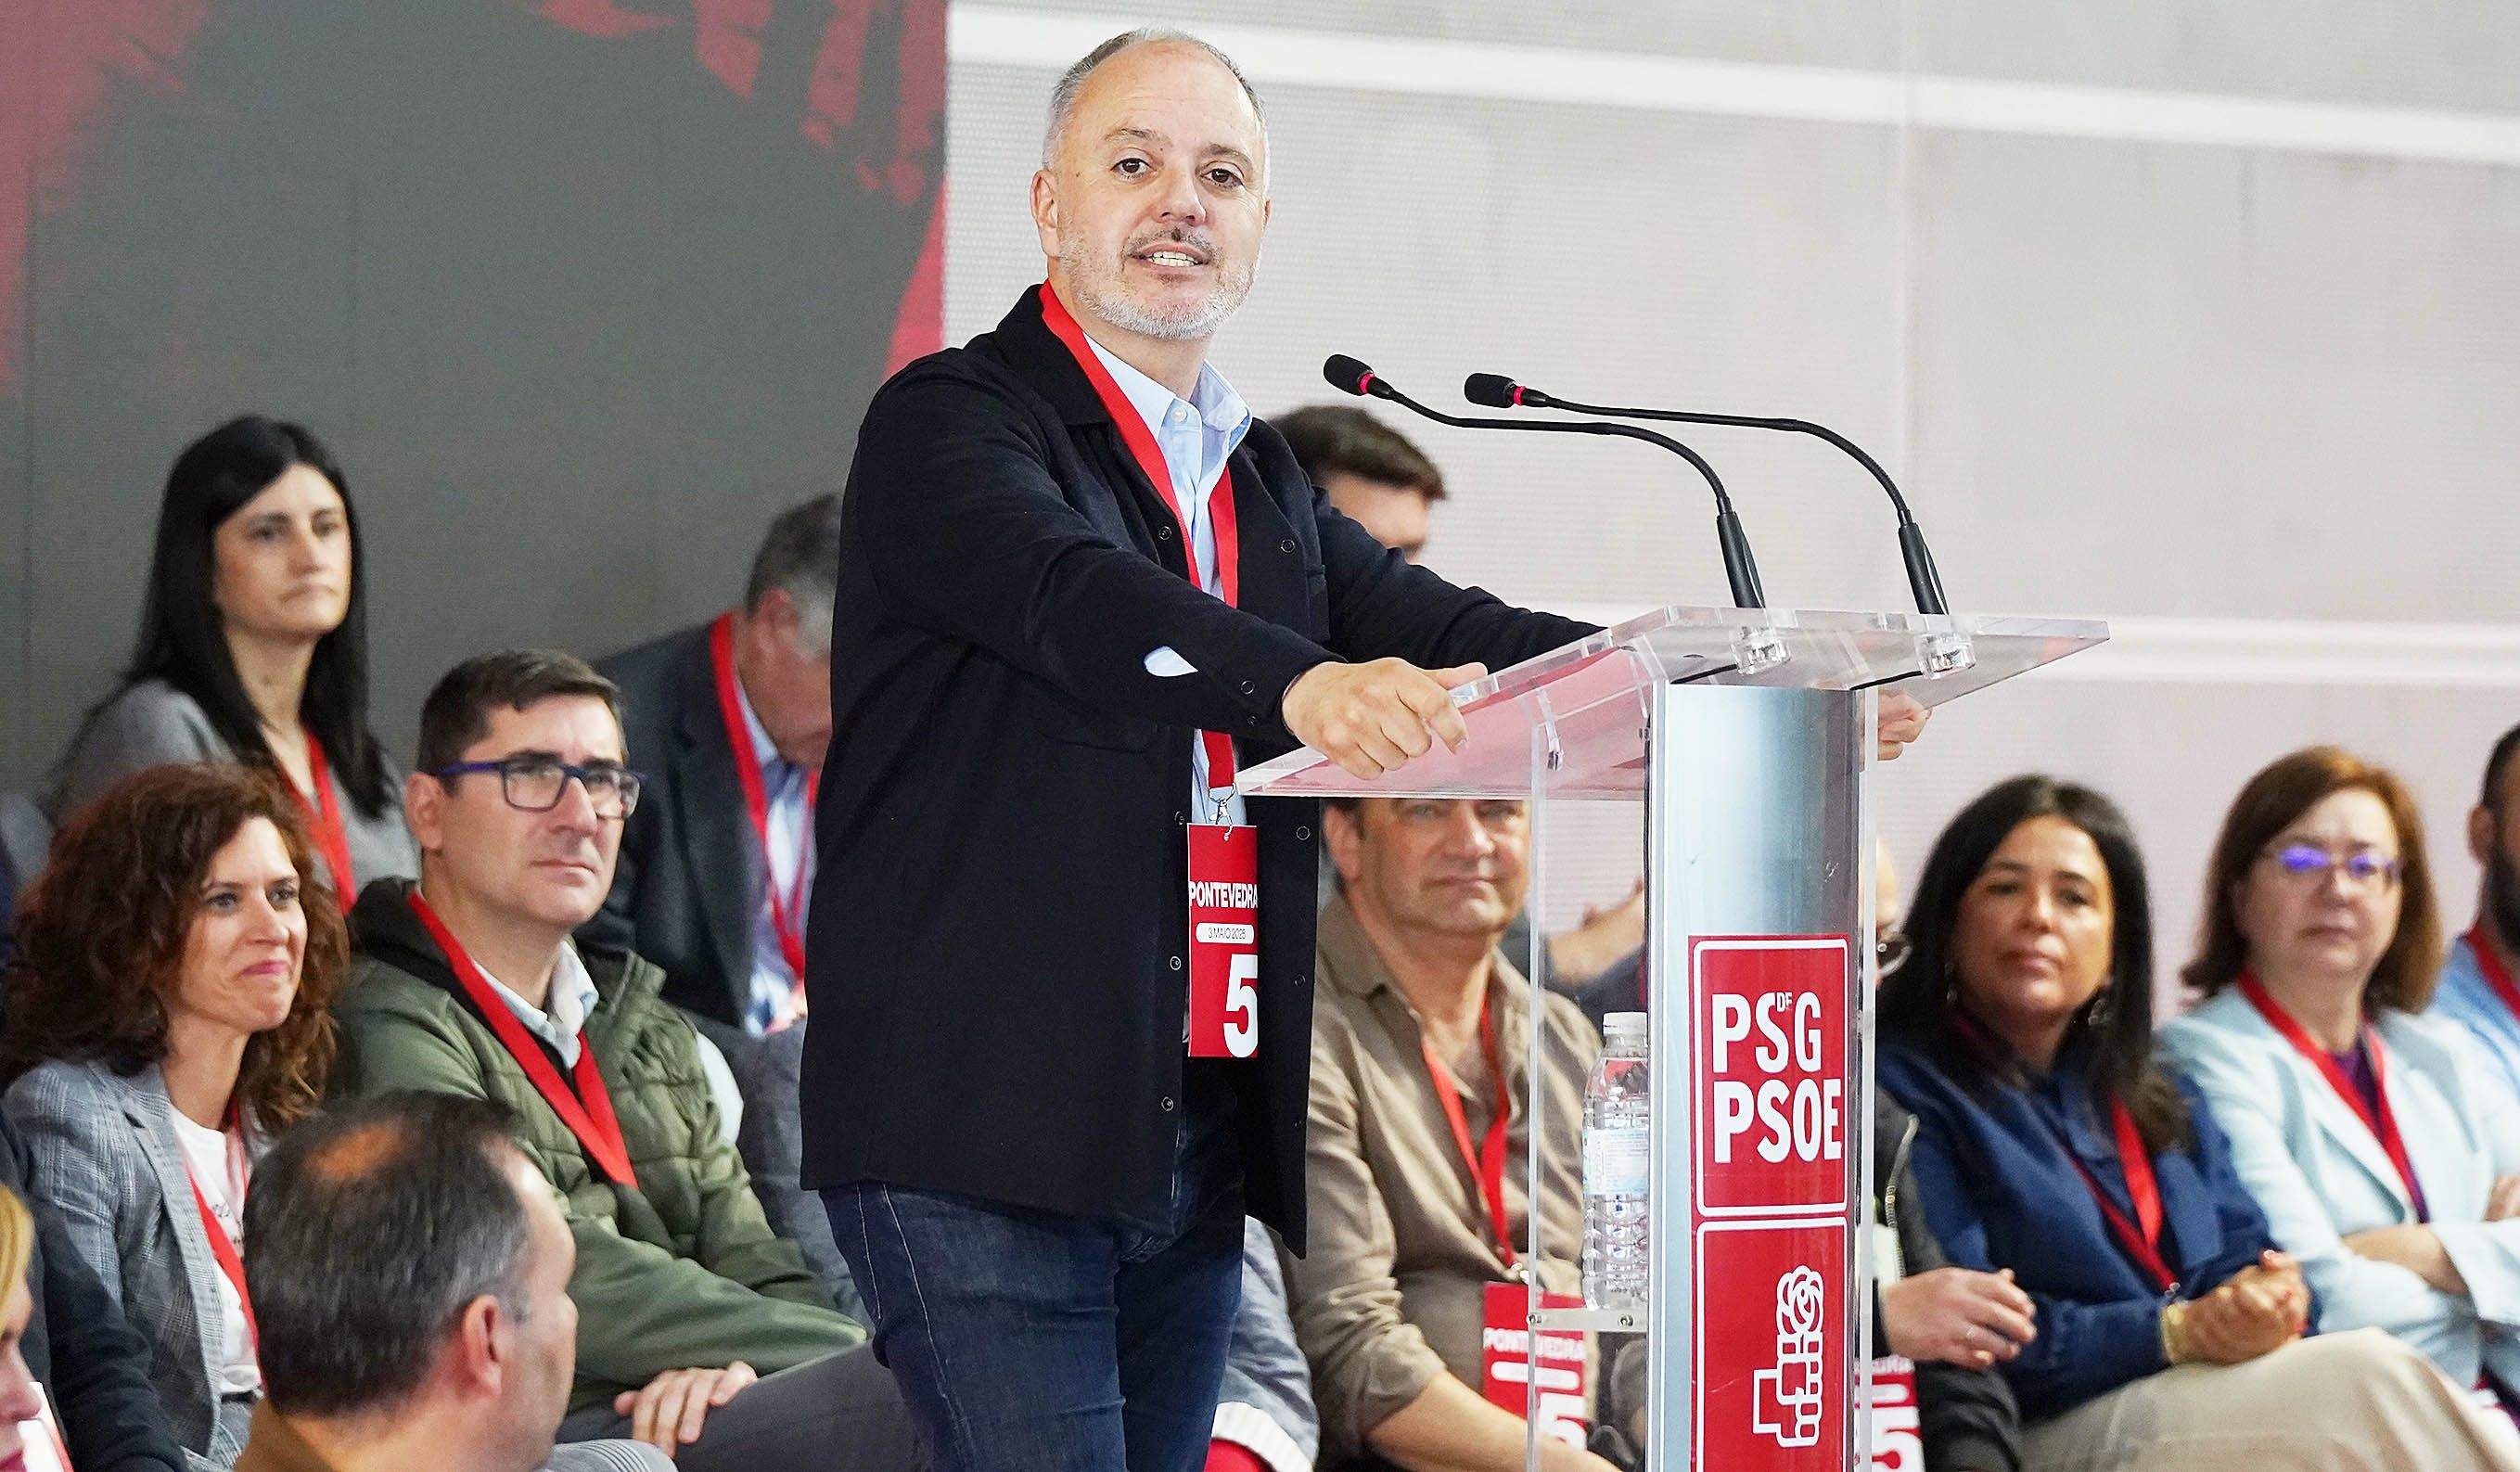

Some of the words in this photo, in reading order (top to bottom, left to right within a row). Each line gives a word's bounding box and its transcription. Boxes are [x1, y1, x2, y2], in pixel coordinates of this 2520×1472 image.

[1188, 881, 1258, 908] PONTEVEDRA
[1223, 954, 1258, 1057] 5
[1714, 1078, 1842, 1163] PSOE
